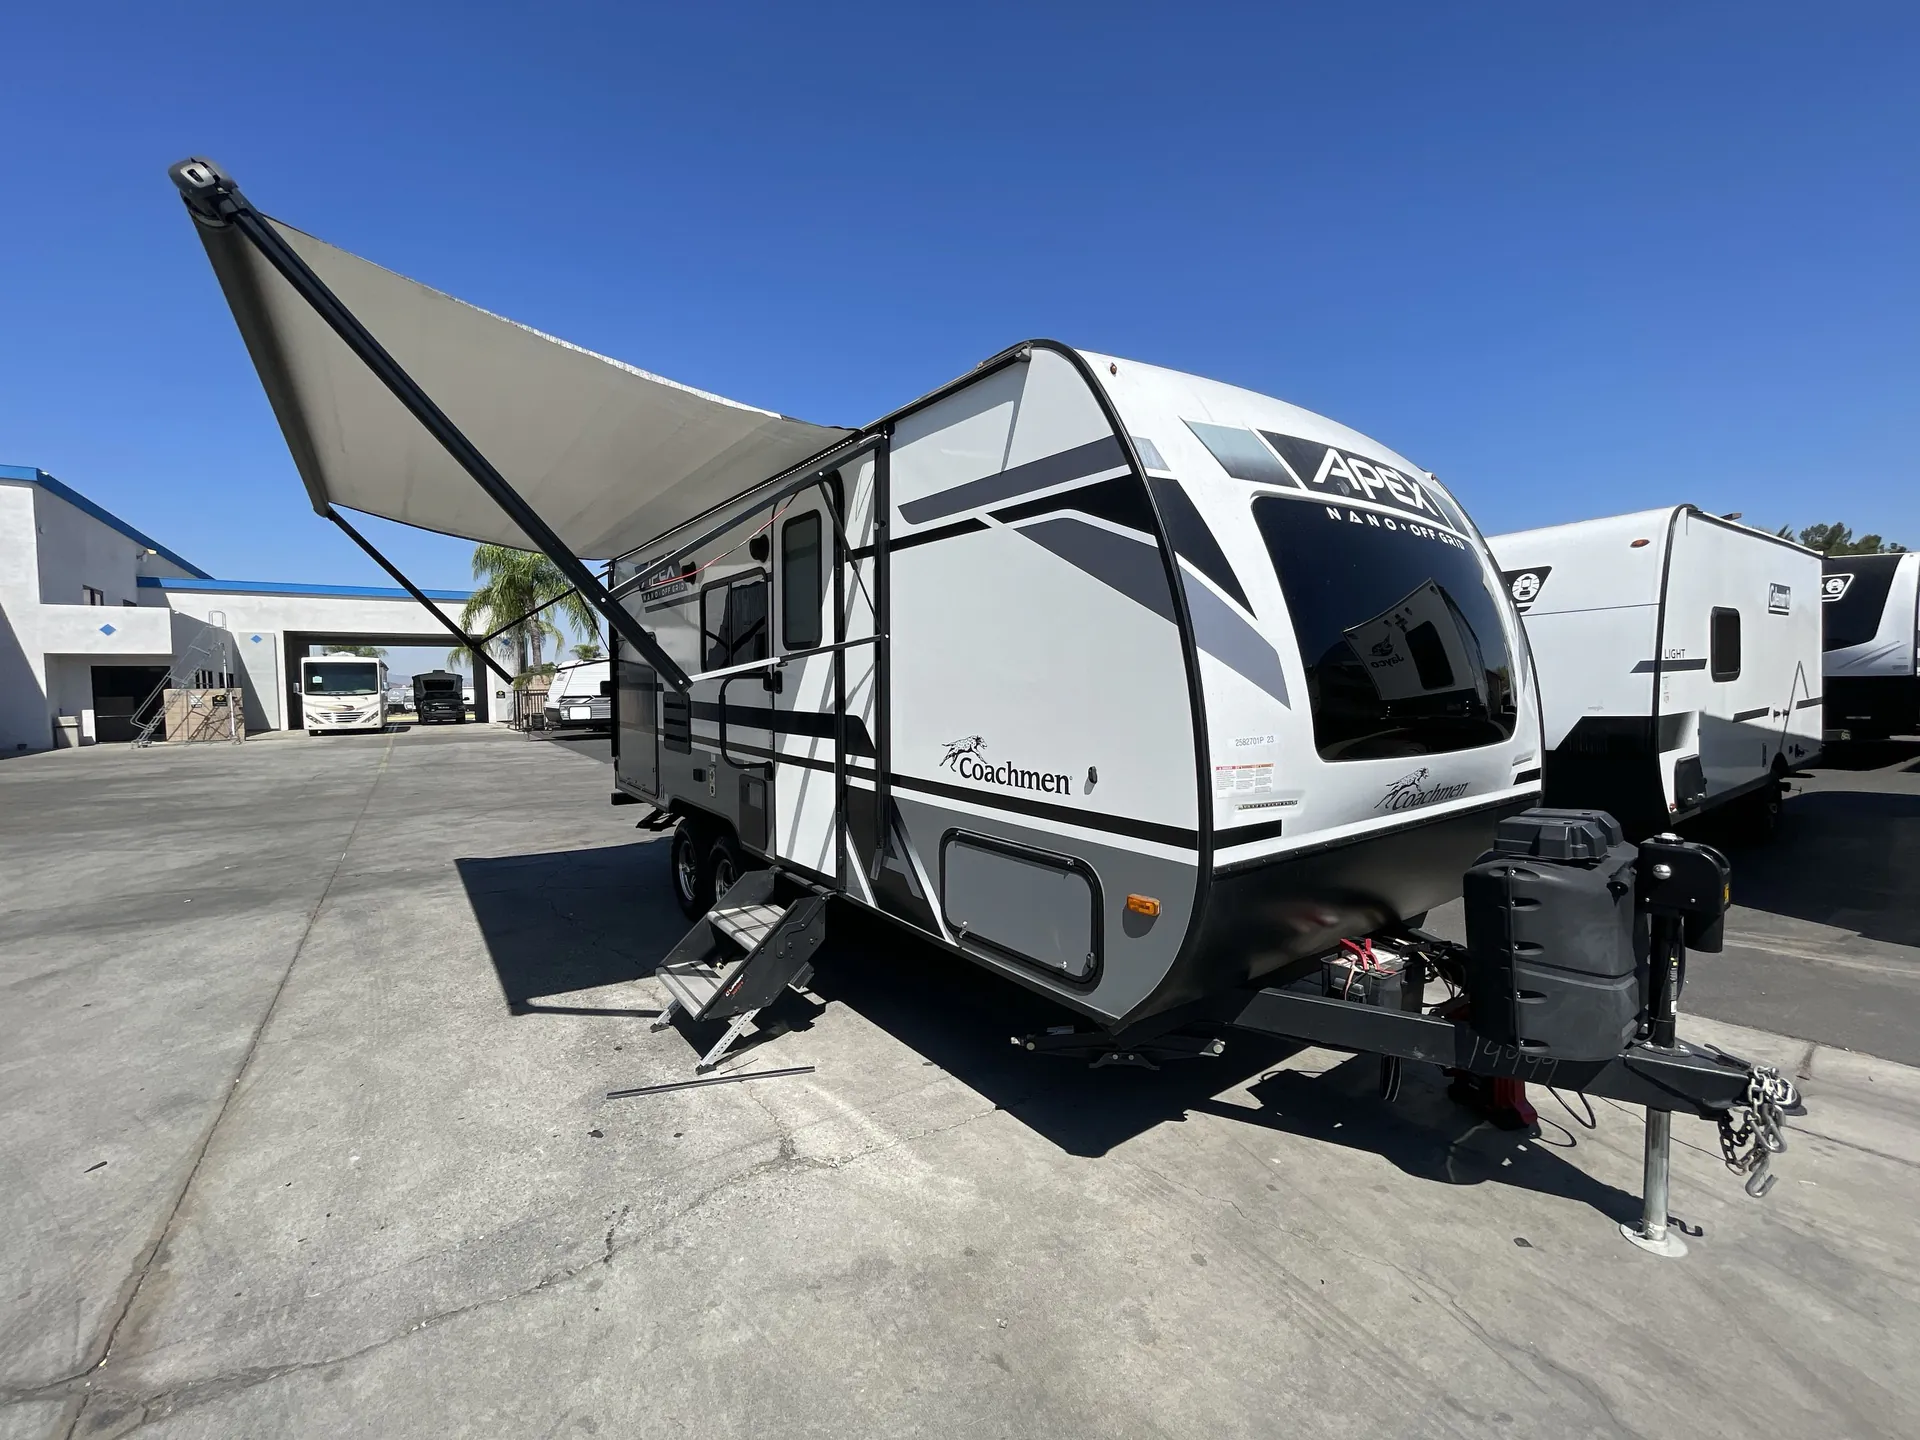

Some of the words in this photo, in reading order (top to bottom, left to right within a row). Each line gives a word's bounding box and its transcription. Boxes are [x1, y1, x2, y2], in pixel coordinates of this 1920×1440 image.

[1312, 447, 1439, 517] APEX
[1326, 506, 1397, 531] NANO
[1409, 523, 1436, 540] OFF
[1438, 531, 1465, 551] GRID
[1664, 648, 1686, 660] LIGHT
[959, 757, 1071, 796] Coachmen
[1392, 782, 1469, 811] Coachmen
